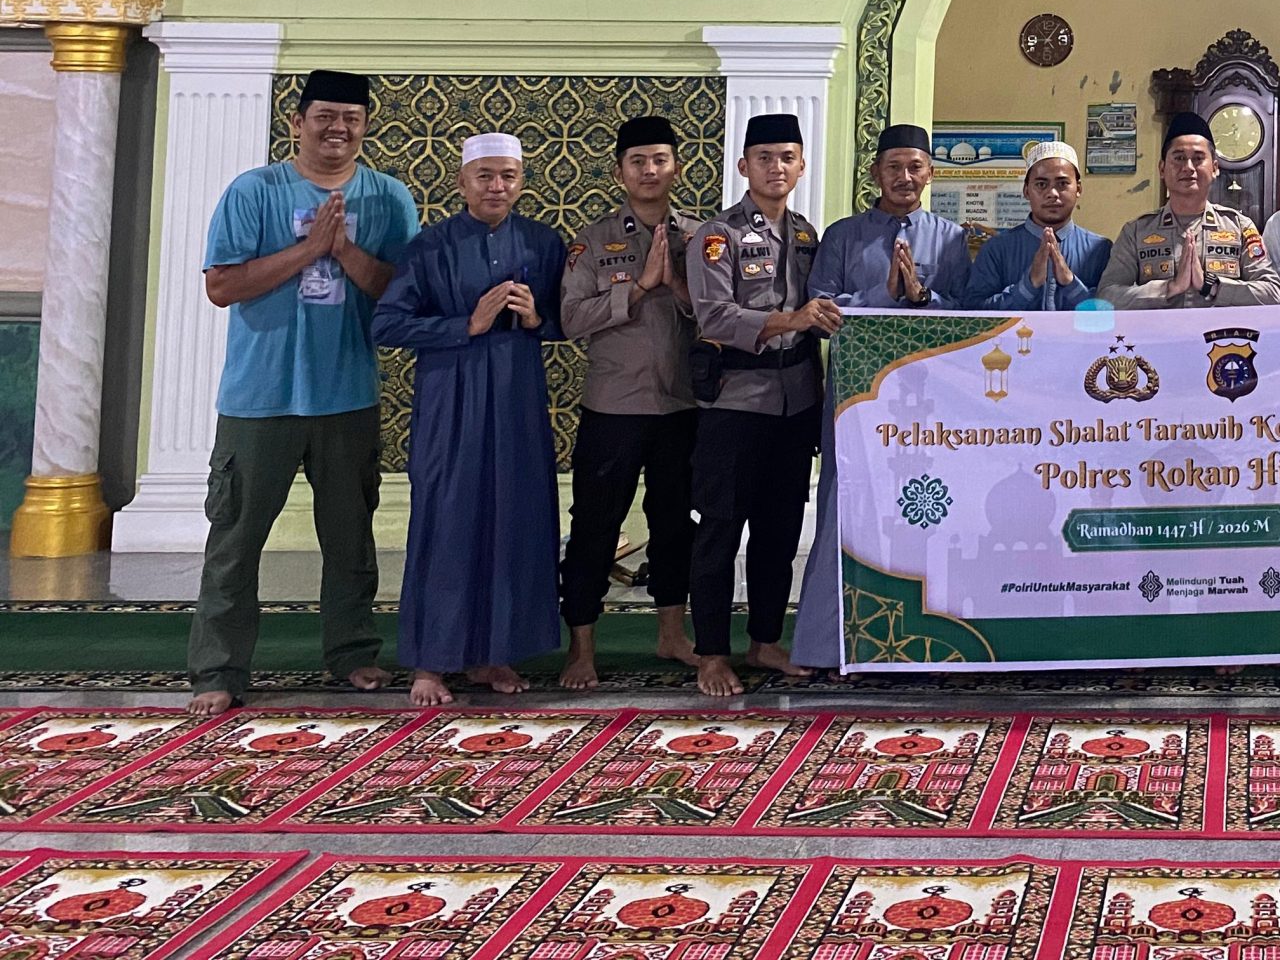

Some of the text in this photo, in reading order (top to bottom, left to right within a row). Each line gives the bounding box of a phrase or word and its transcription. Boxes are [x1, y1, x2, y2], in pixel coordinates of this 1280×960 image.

[740, 246, 771, 258] ALWI
[1139, 247, 1172, 259] DIDI.S
[1207, 245, 1240, 256] POLRI
[599, 254, 636, 268] SETYO
[1209, 330, 1254, 340] RIAU
[876, 421, 1042, 450] Pelaksanaan
[1048, 418, 1132, 447] Shalat
[1136, 415, 1244, 445] Tarawih
[1034, 460, 1132, 491] Polres
[1138, 457, 1240, 493] Rokan
[1076, 521, 1154, 539] Ramadhan
[1157, 524, 1187, 539] 1447
[1189, 518, 1205, 537] H
[1217, 519, 1250, 535] 2026
[1252, 517, 1271, 534] M
[1000, 580, 1131, 594] #PolriUntukMasyarakat
[1166, 575, 1245, 588] Melindungi Tuah
[1166, 585, 1249, 598] Menjaga Marwah
